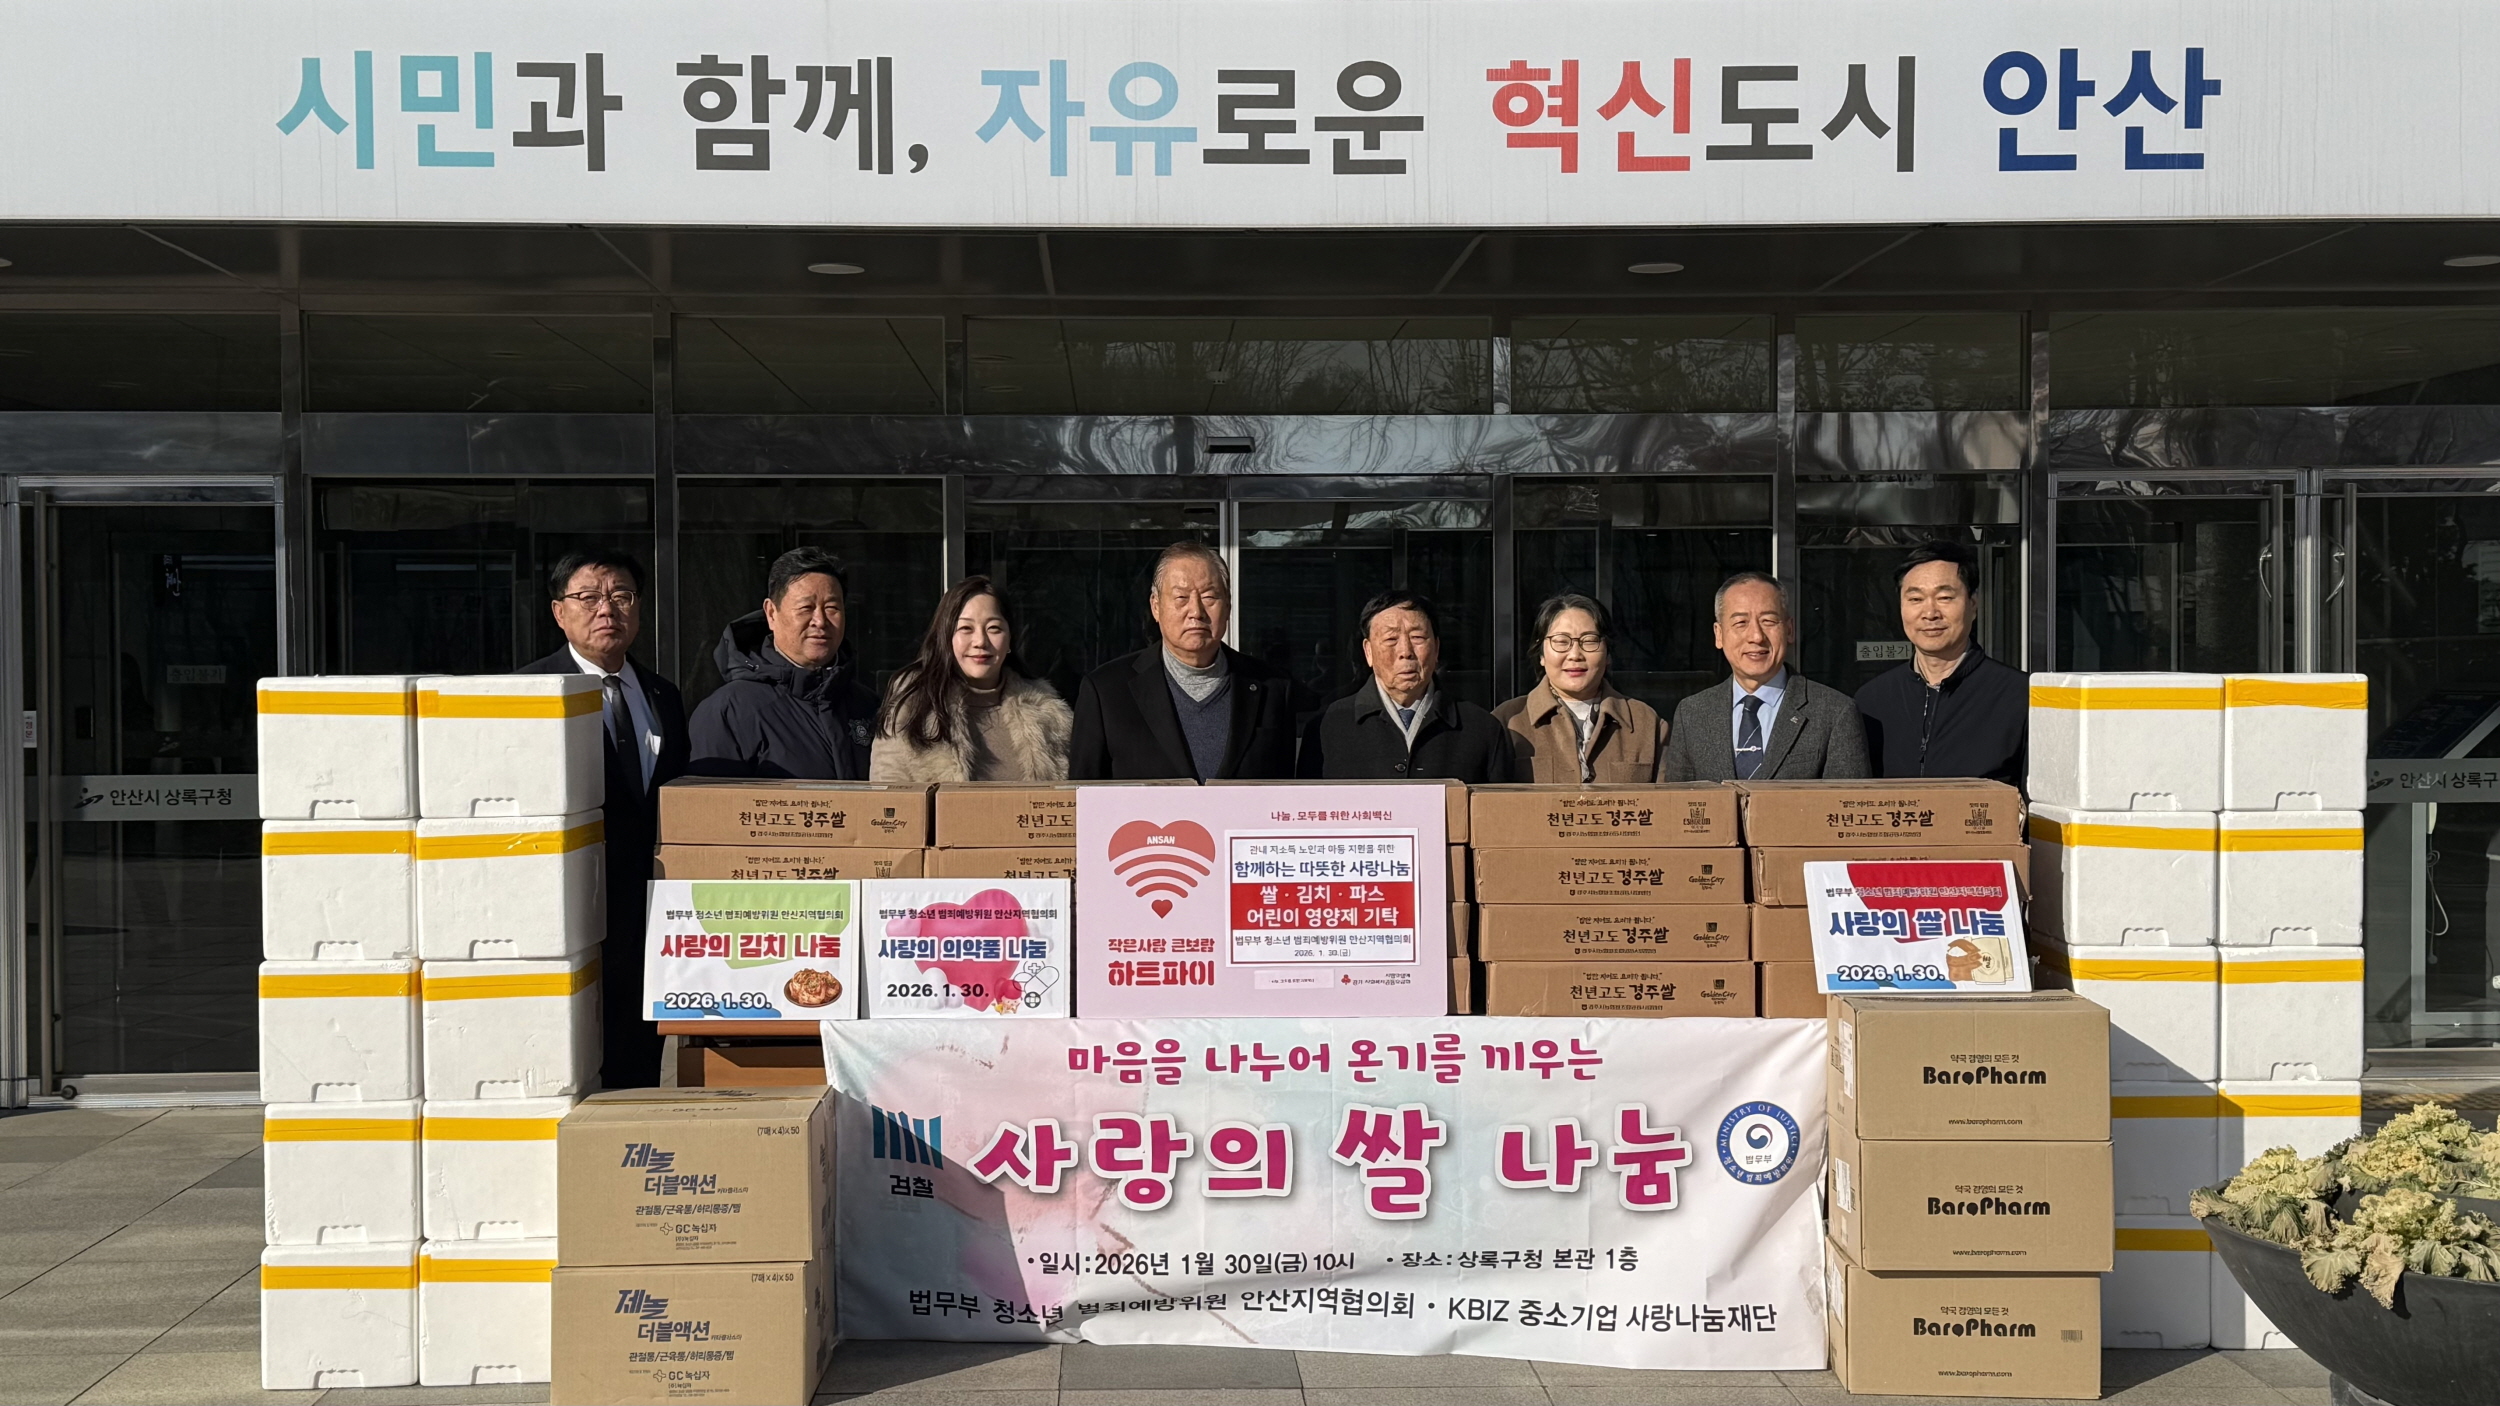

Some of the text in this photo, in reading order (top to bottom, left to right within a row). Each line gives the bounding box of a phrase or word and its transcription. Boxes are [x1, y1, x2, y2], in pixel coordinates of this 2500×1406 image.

[275, 47, 2222, 177] 시민과 함께, 자유로운 혁신도시 안산
[1859, 644, 1910, 659] 출입불가
[2400, 771, 2448, 789] 안산시
[109, 788, 232, 806] 안산시 상록구청
[738, 810, 847, 828] 천년고도 경주쌀
[1016, 813, 1073, 828] 천년고도
[1297, 811, 1327, 821] 모두를
[1330, 811, 1350, 821] 위한
[1351, 810, 1392, 821] 사회백신
[1547, 808, 1653, 826] 천년고도 경주쌀
[1826, 809, 1935, 828] 천년고도 경주쌀
[1146, 835, 1176, 845] ANSAN
[1299, 845, 1325, 855] 노인과
[1376, 844, 1395, 854] 위한
[1234, 860, 1411, 878] 함께하는 따뜻한 사랑나눔
[1558, 868, 1665, 886] 천년고도 경주쌀
[1259, 884, 1385, 905] 쌀 김치 파스
[1825, 887, 1852, 898] 법무부
[666, 909, 844, 921] 법무부 청소년 범죄예방위원 안산지역협의회
[880, 909, 1058, 921] 법무부 청소년 범죄예방위원 안산지역협의회
[1246, 906, 1399, 928] 어린이 영양제 기탁
[1829, 910, 2006, 937] 사랑의 쌀 나눔
[1235, 934, 1411, 946] 법무부 청소년 범죄예방위원 안산지역협의회
[1562, 926, 1670, 944] 천년고도 경주쌀
[660, 933, 842, 959] 사랑의 김치 나눔
[878, 937, 1047, 960] 사랑의 의약품 나눔
[1107, 937, 1216, 954] 작은사랑 큰보람
[1294, 949, 1315, 957] 2026.
[1107, 960, 1215, 987] 하트파이
[1837, 964, 1946, 982] 2026. 1. 30.
[886, 983, 990, 999] 2026. 1. 30.
[1570, 982, 1677, 1000] 천년고도 경주쌀
[664, 992, 773, 1011] 2026. 1. 30.
[1068, 1033, 1603, 1086] 마음을 나누어 온기를 끼우는
[1923, 1066, 2047, 1086] BaroPharm
[1720, 1104, 1798, 1148] MINISTRY OF JUSTICE
[620, 1143, 676, 1173] 제놀
[972, 1105, 1689, 1216] 사랑의 쌀 나눔
[1745, 1154, 1772, 1165] 법무부
[643, 1173, 717, 1196] 더블액션
[889, 1174, 935, 1199] 검찰
[1927, 1196, 2051, 1216] BaroPharm
[675, 1223, 717, 1234] GC 녹십자
[1180, 1251, 1215, 1276] 1월
[1224, 1251, 1308, 1276] 30일(금)
[1313, 1251, 1355, 1272] 10시
[1552, 1247, 1596, 1270] 본관
[1606, 1246, 1639, 1271] 1층
[614, 1289, 669, 1320] 제놀
[908, 1287, 1778, 1333] 법무부 청소년 범죄예방위원 안산지역협의회 KBIZ 중소기업 사랑나눔재단
[637, 1320, 711, 1342] 더블액션
[1913, 1317, 2036, 1338] BaroPharm
[668, 1370, 710, 1381] GC 녹십자
